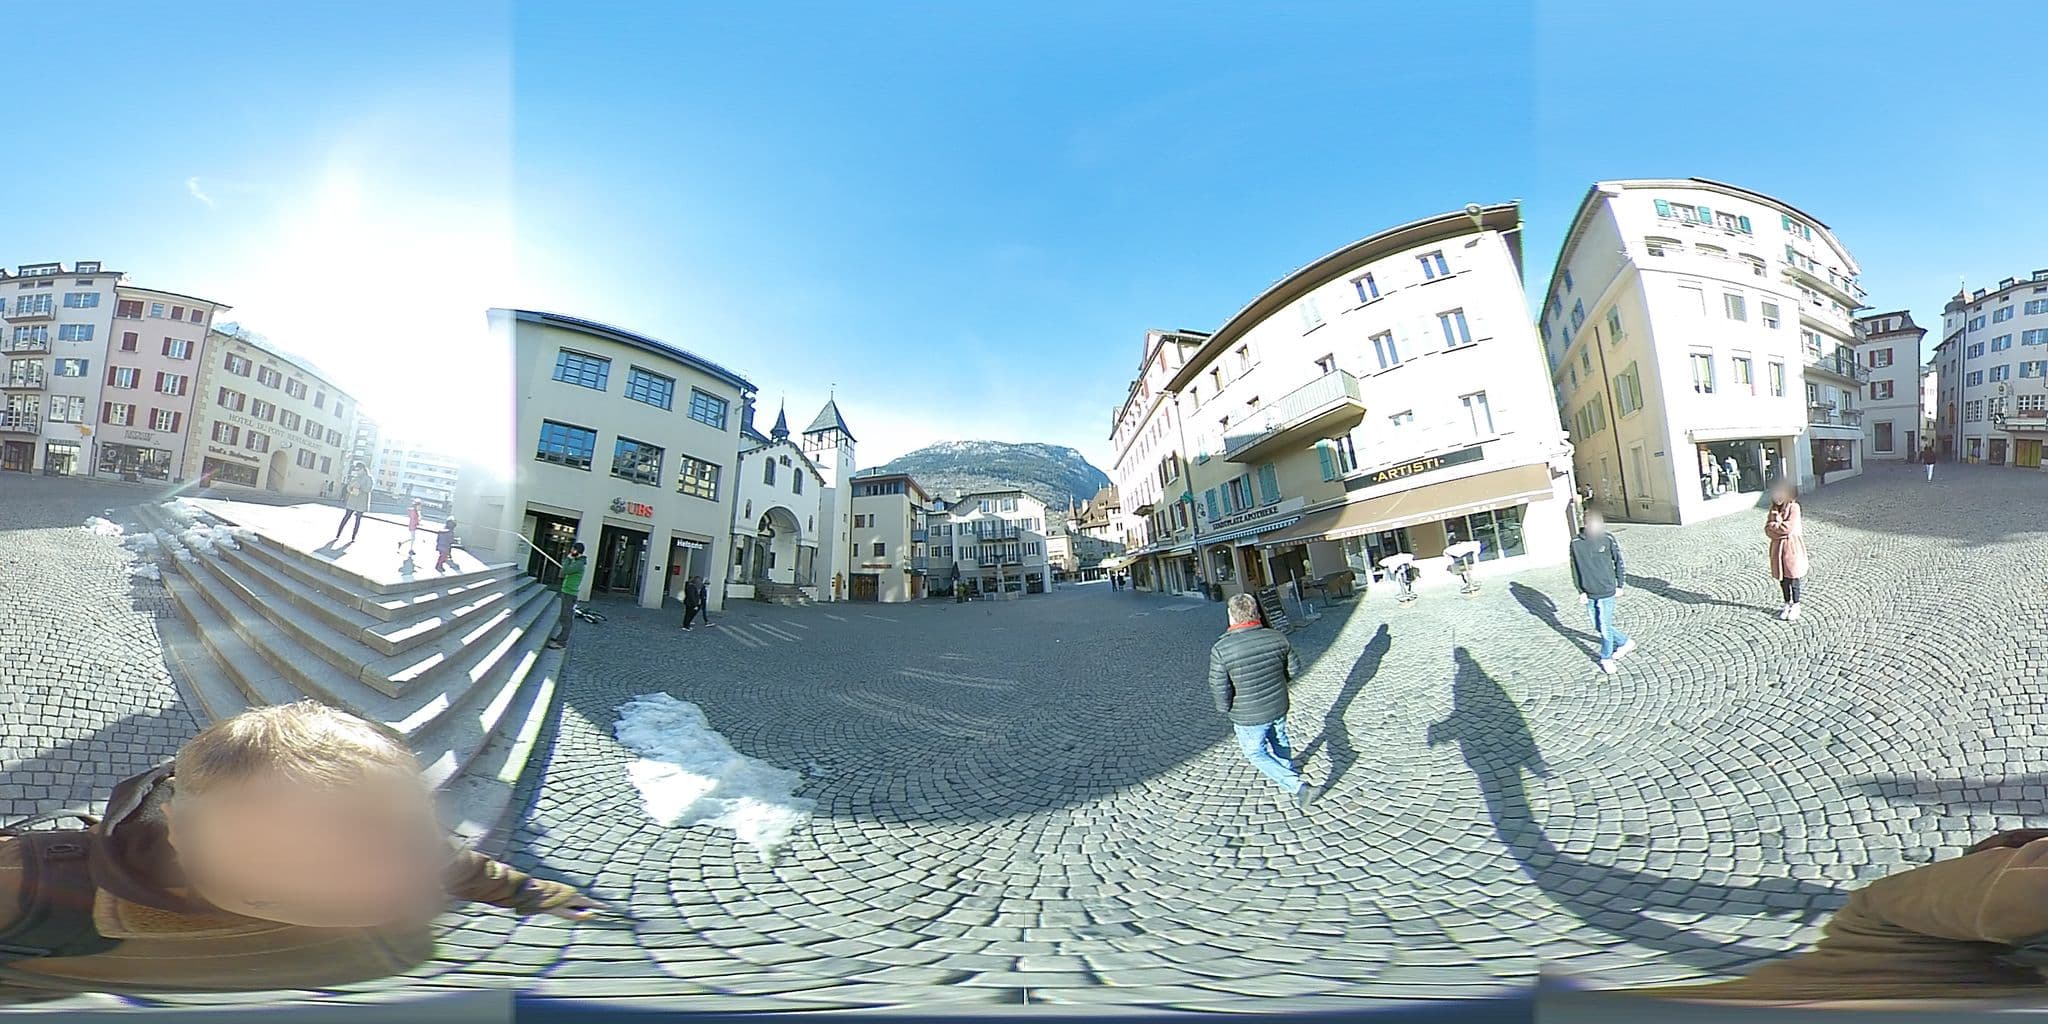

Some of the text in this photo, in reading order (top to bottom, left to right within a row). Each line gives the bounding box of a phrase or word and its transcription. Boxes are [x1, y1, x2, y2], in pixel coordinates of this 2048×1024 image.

[229, 413, 253, 426] HOTEL
[1378, 458, 1440, 482] ARTISTI
[627, 501, 654, 518] UBS
